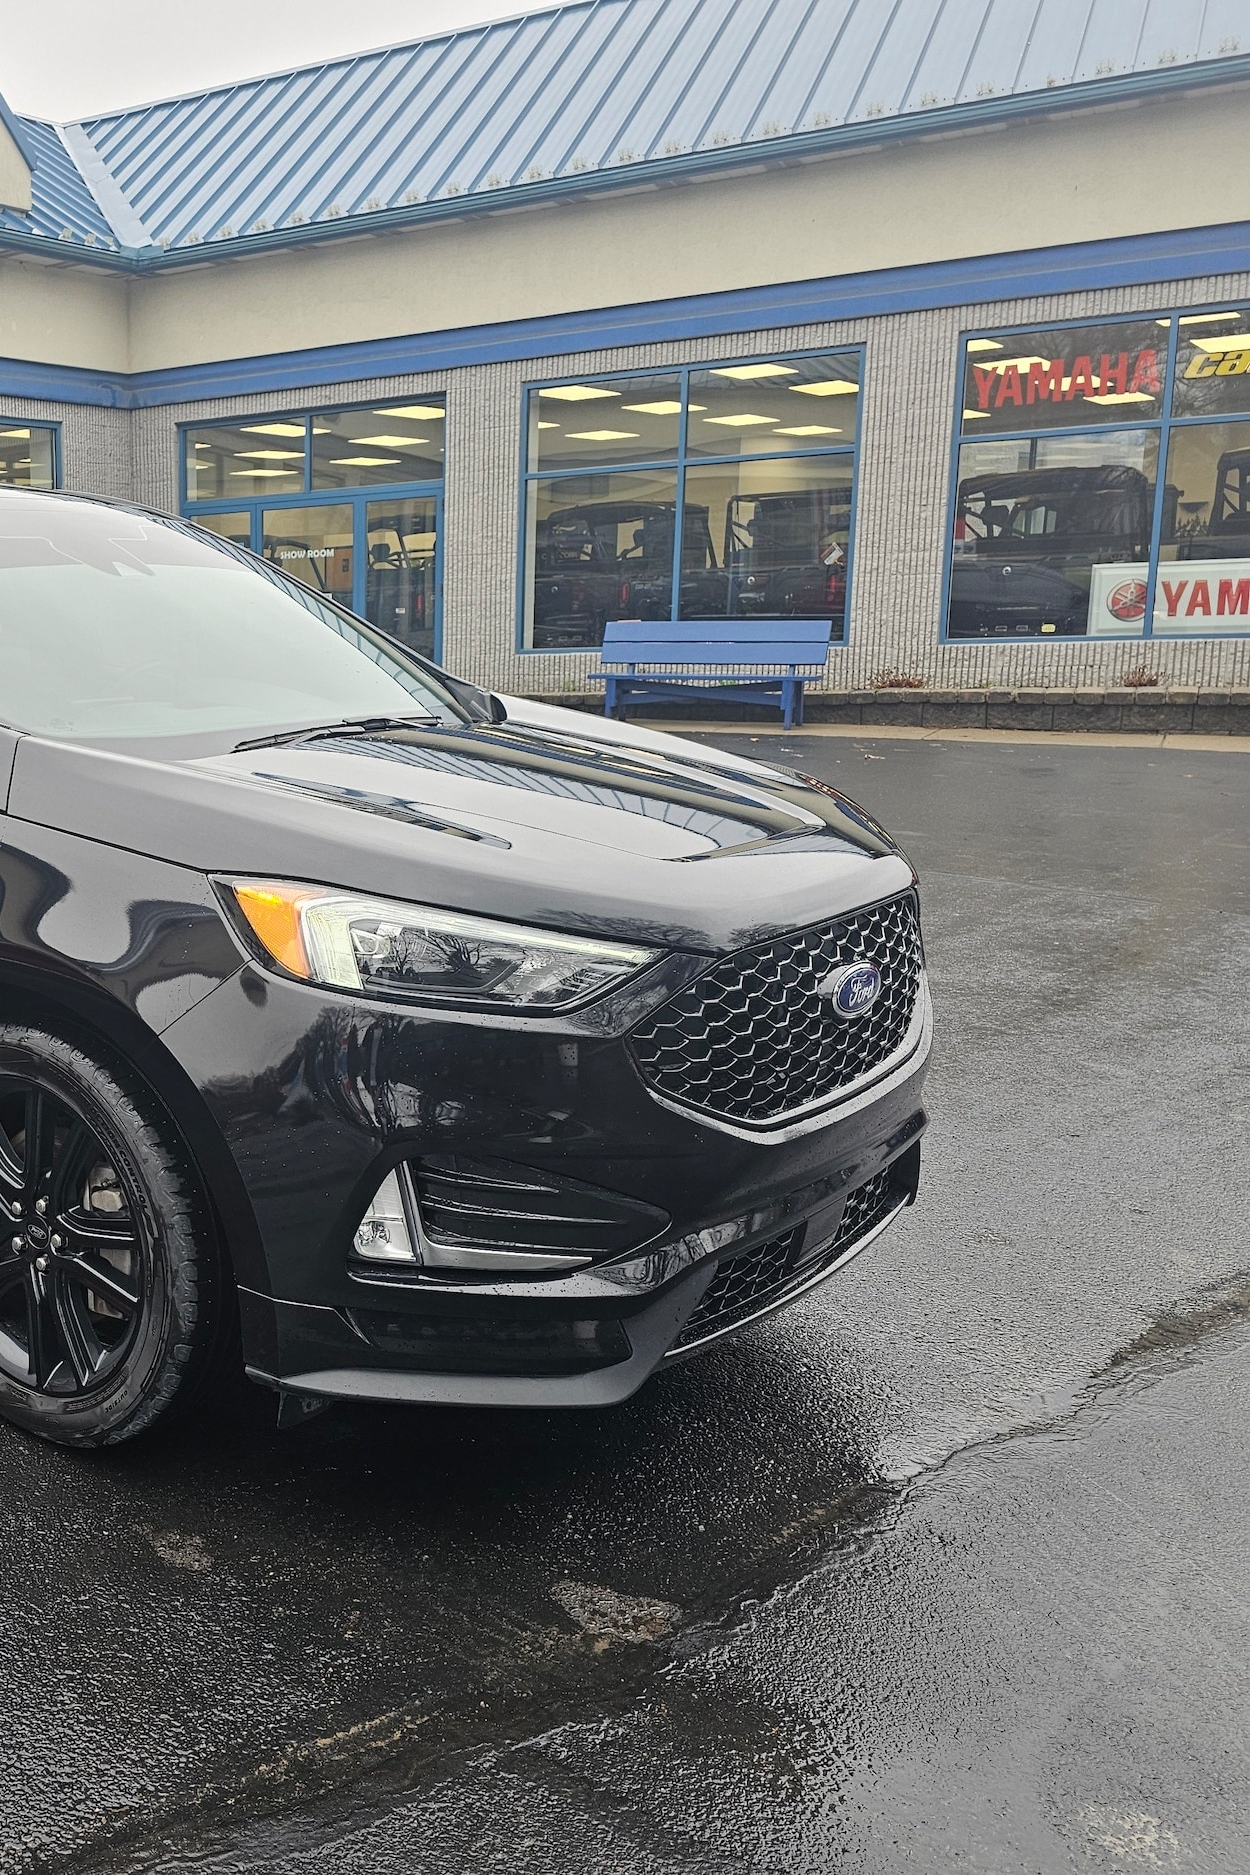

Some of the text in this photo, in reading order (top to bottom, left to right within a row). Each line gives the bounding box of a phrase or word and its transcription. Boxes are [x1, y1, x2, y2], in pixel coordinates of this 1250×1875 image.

[973, 348, 1160, 409] YAMAHA
[1183, 349, 1250, 379] ca
[280, 548, 335, 560] SHOW ROOM
[1161, 578, 1250, 617] YAM
[848, 974, 875, 1007] Ford
